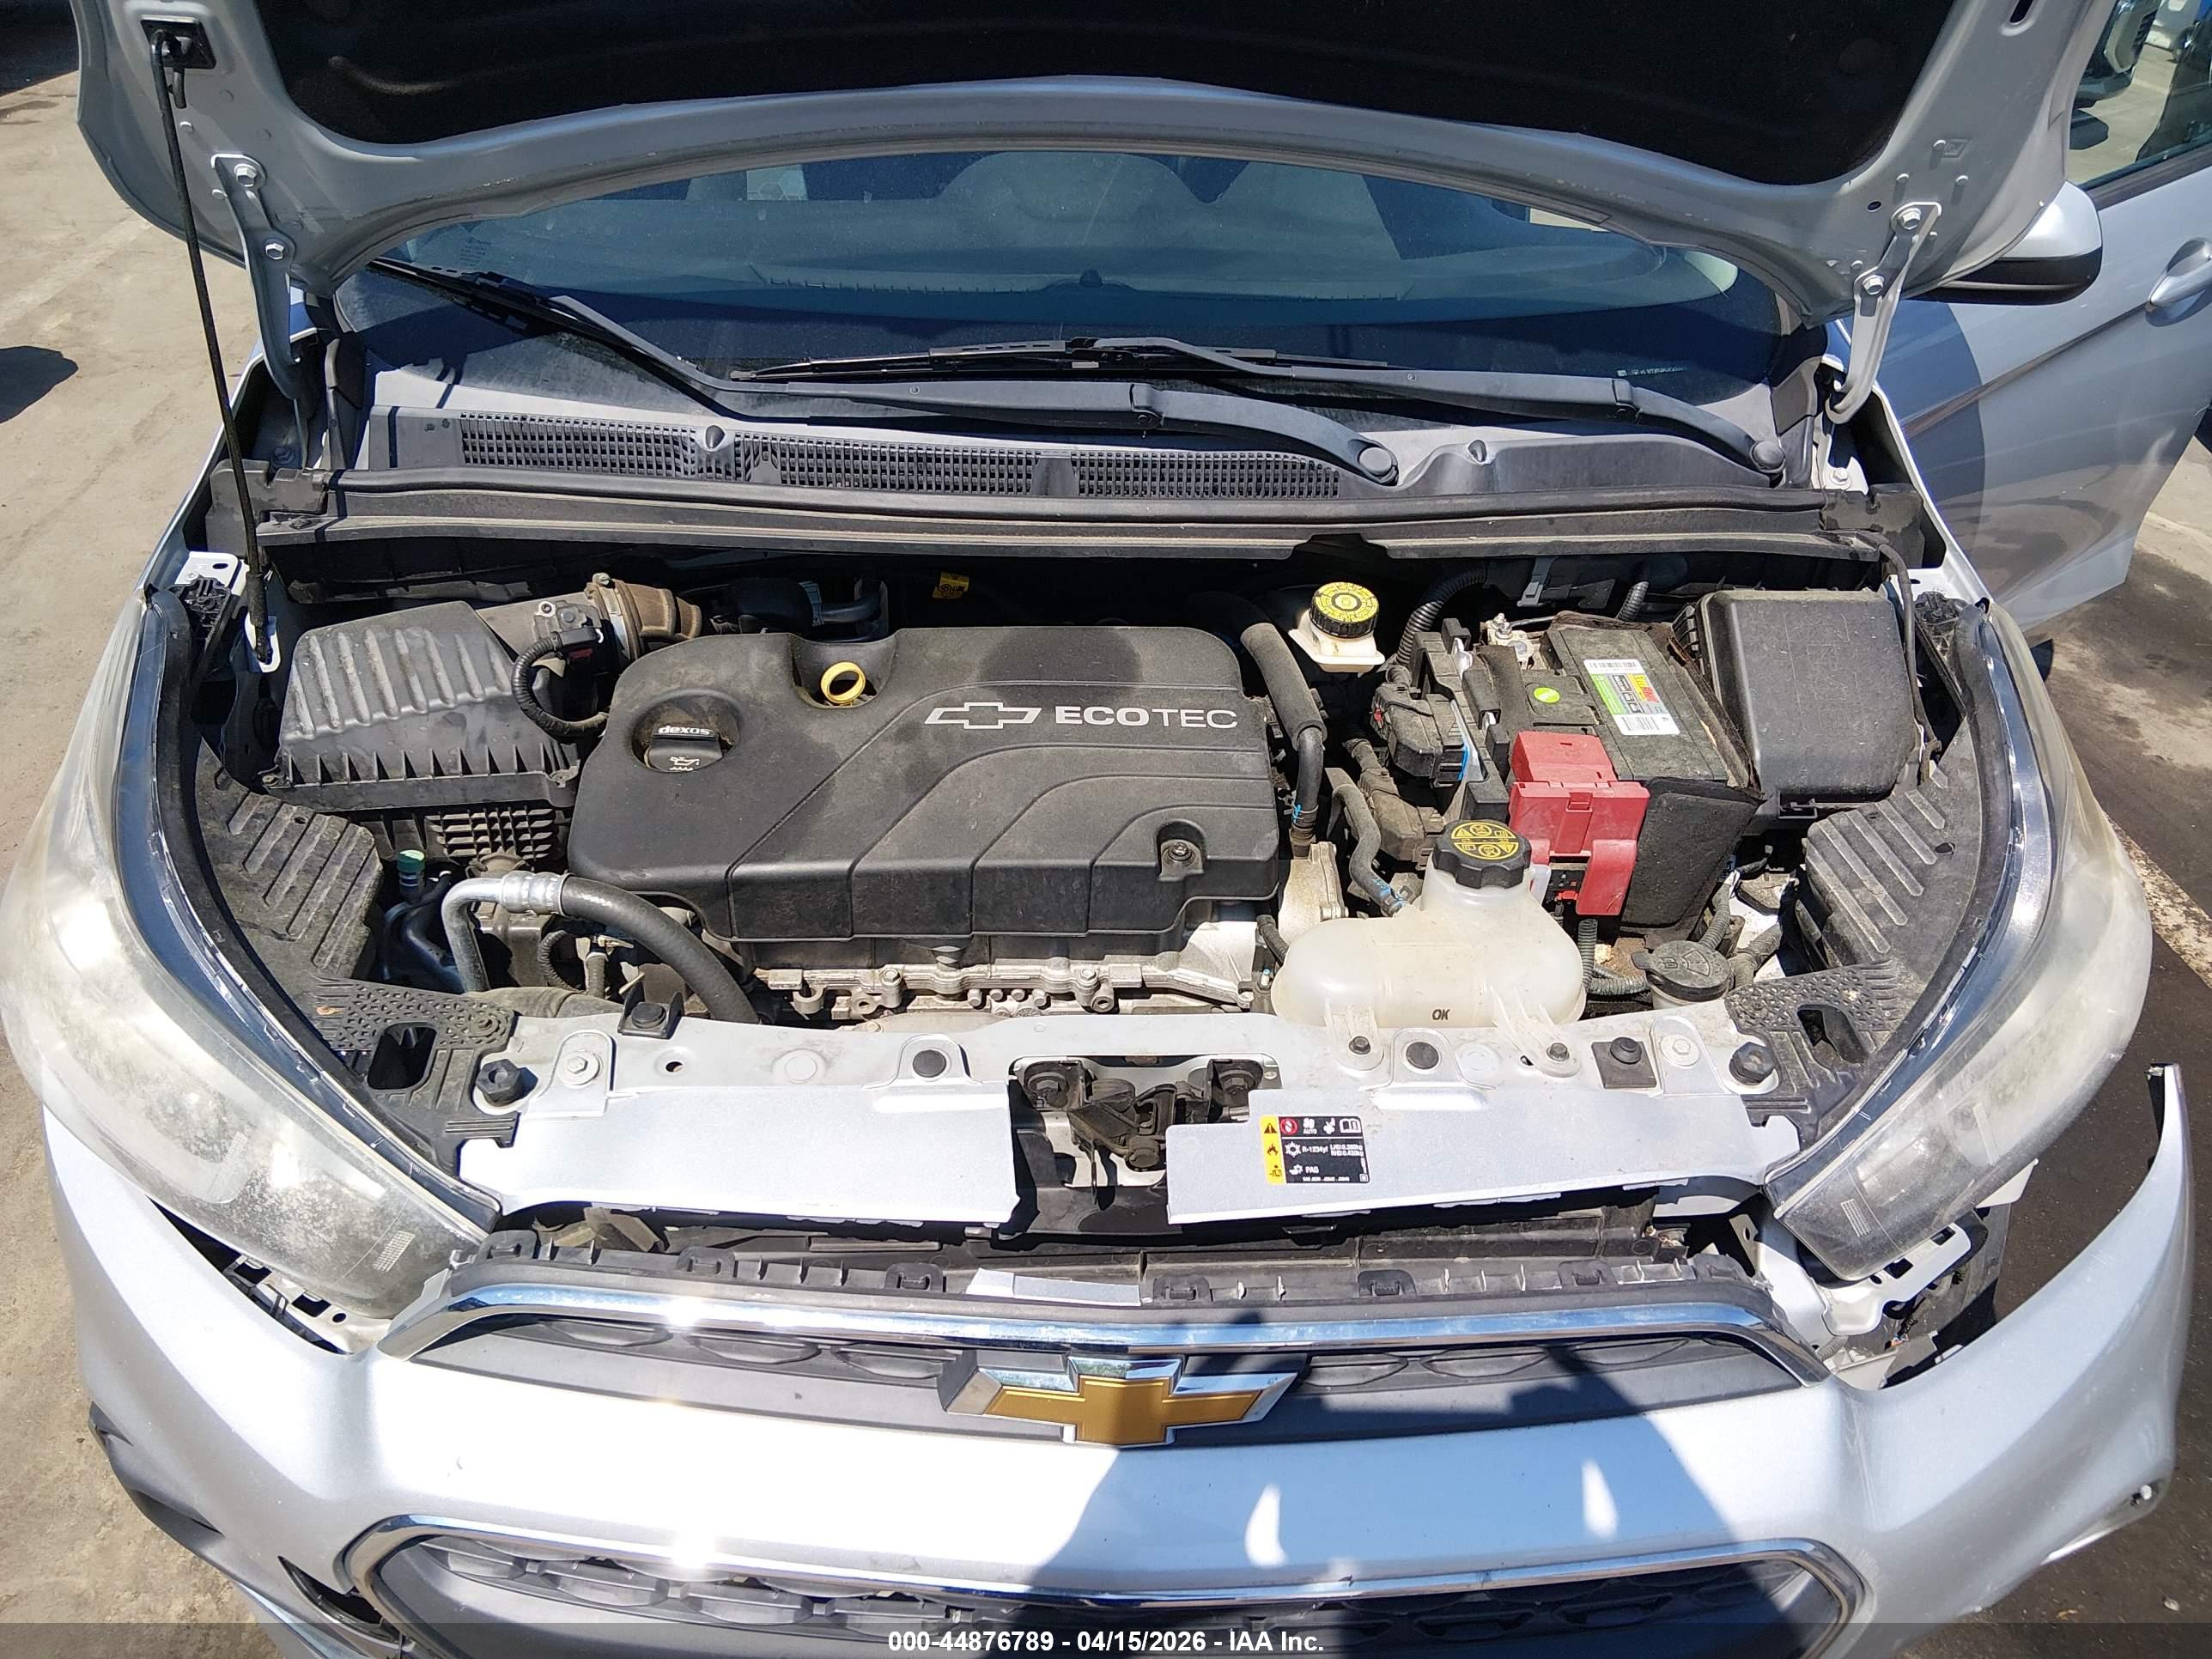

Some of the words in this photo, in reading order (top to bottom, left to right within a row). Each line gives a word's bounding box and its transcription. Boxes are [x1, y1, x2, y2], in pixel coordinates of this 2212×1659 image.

[1055, 705, 1238, 729] ECOTEC
[658, 725, 714, 735] dexos
[1431, 1009, 1450, 1021] OK
